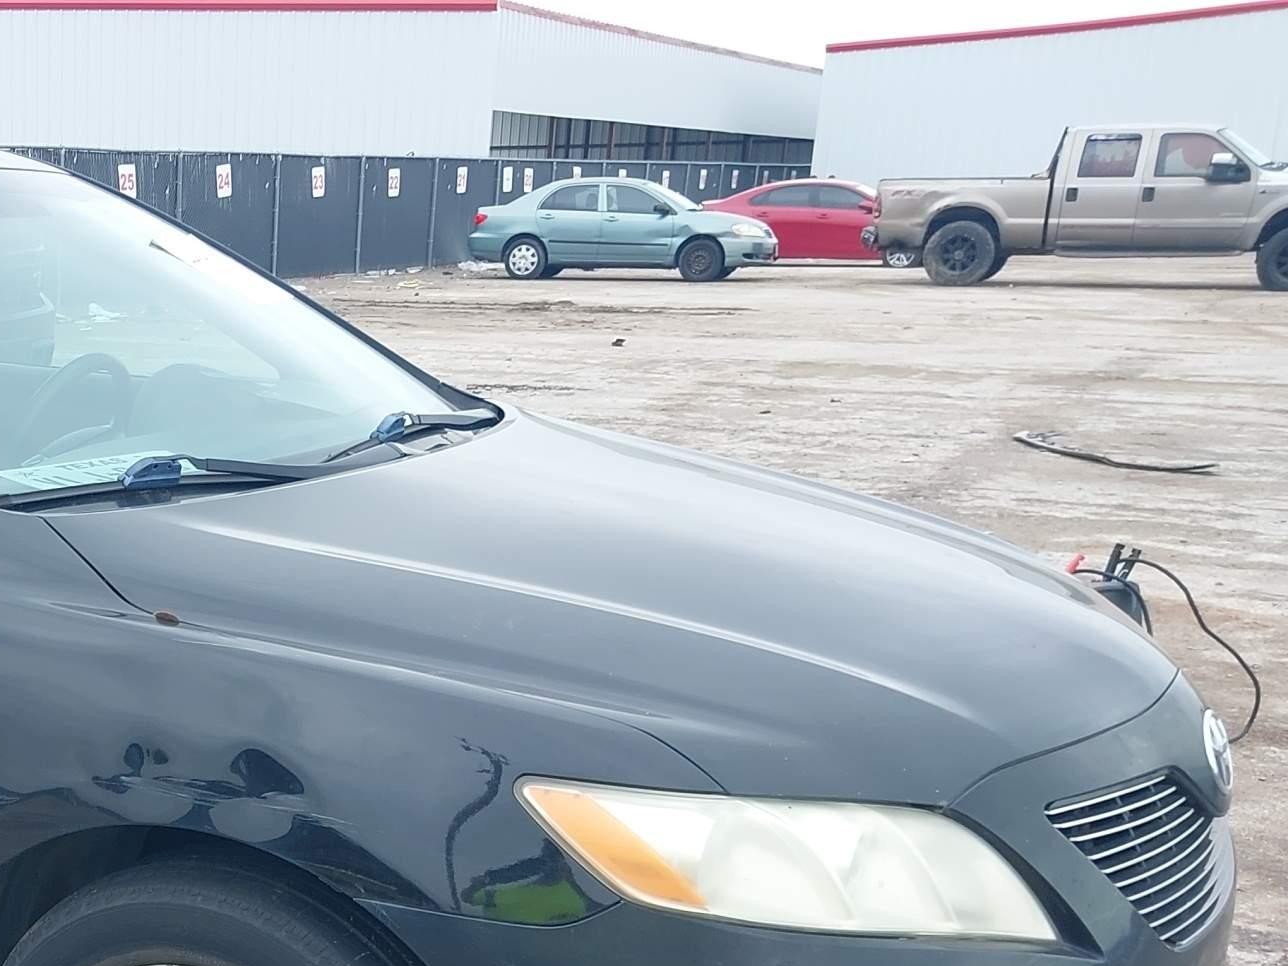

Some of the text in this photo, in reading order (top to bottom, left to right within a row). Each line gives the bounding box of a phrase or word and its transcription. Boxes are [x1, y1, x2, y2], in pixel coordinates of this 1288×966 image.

[120, 174, 135, 191] 25
[218, 173, 230, 189] 24
[313, 174, 324, 190] 23
[389, 175, 399, 190] 22
[457, 173, 466, 188] 21
[55, 457, 129, 471] TEXAS
